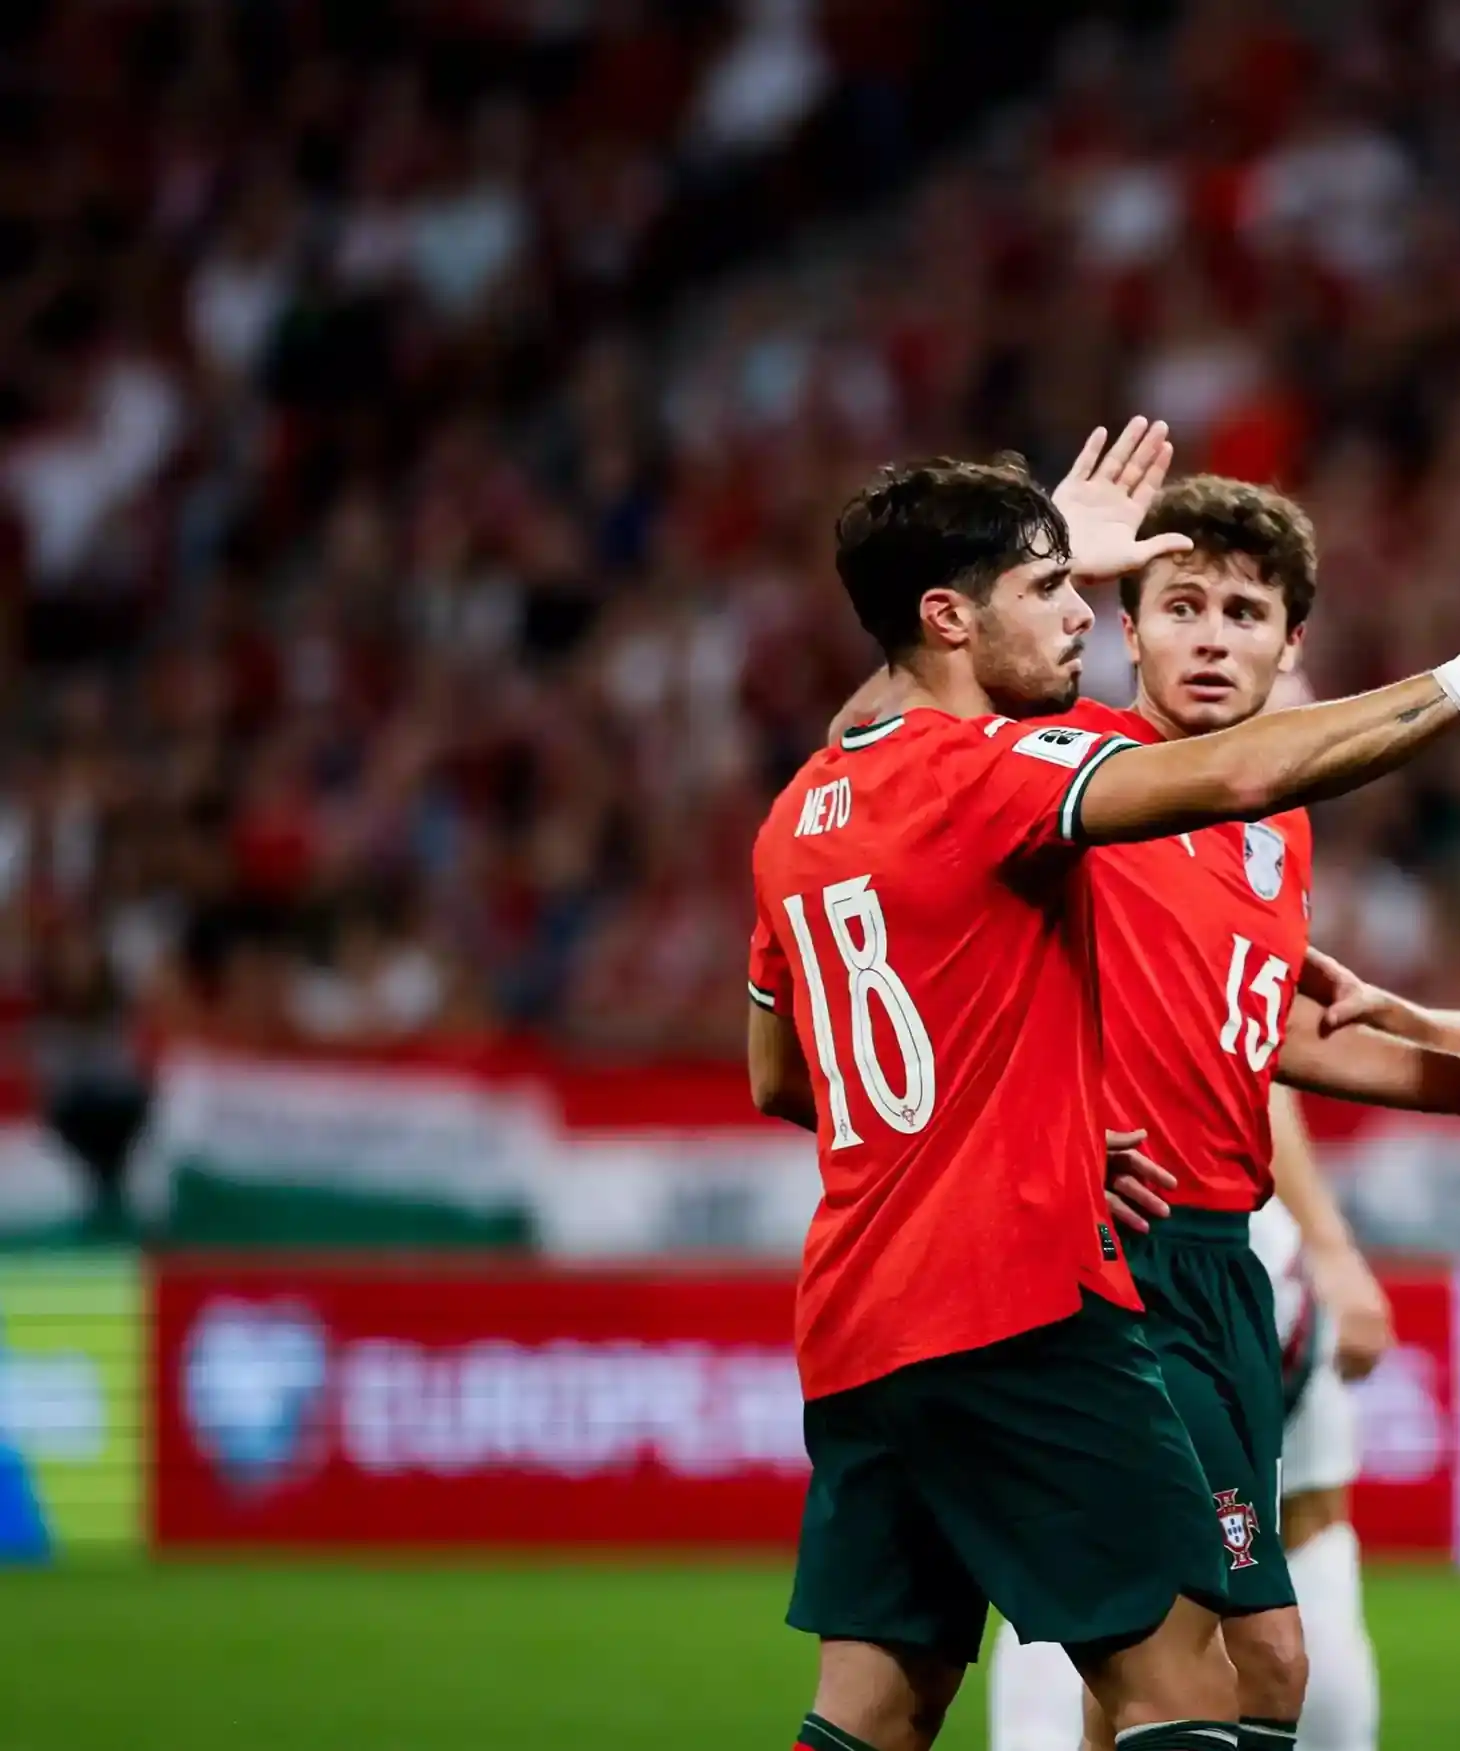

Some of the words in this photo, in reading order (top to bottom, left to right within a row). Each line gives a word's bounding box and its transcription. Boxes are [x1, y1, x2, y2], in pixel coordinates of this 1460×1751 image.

[793, 776, 852, 838] NETO
[782, 874, 936, 1151] 18
[1219, 932, 1290, 1073] 15
[345, 1340, 806, 1474] EUROPEA
